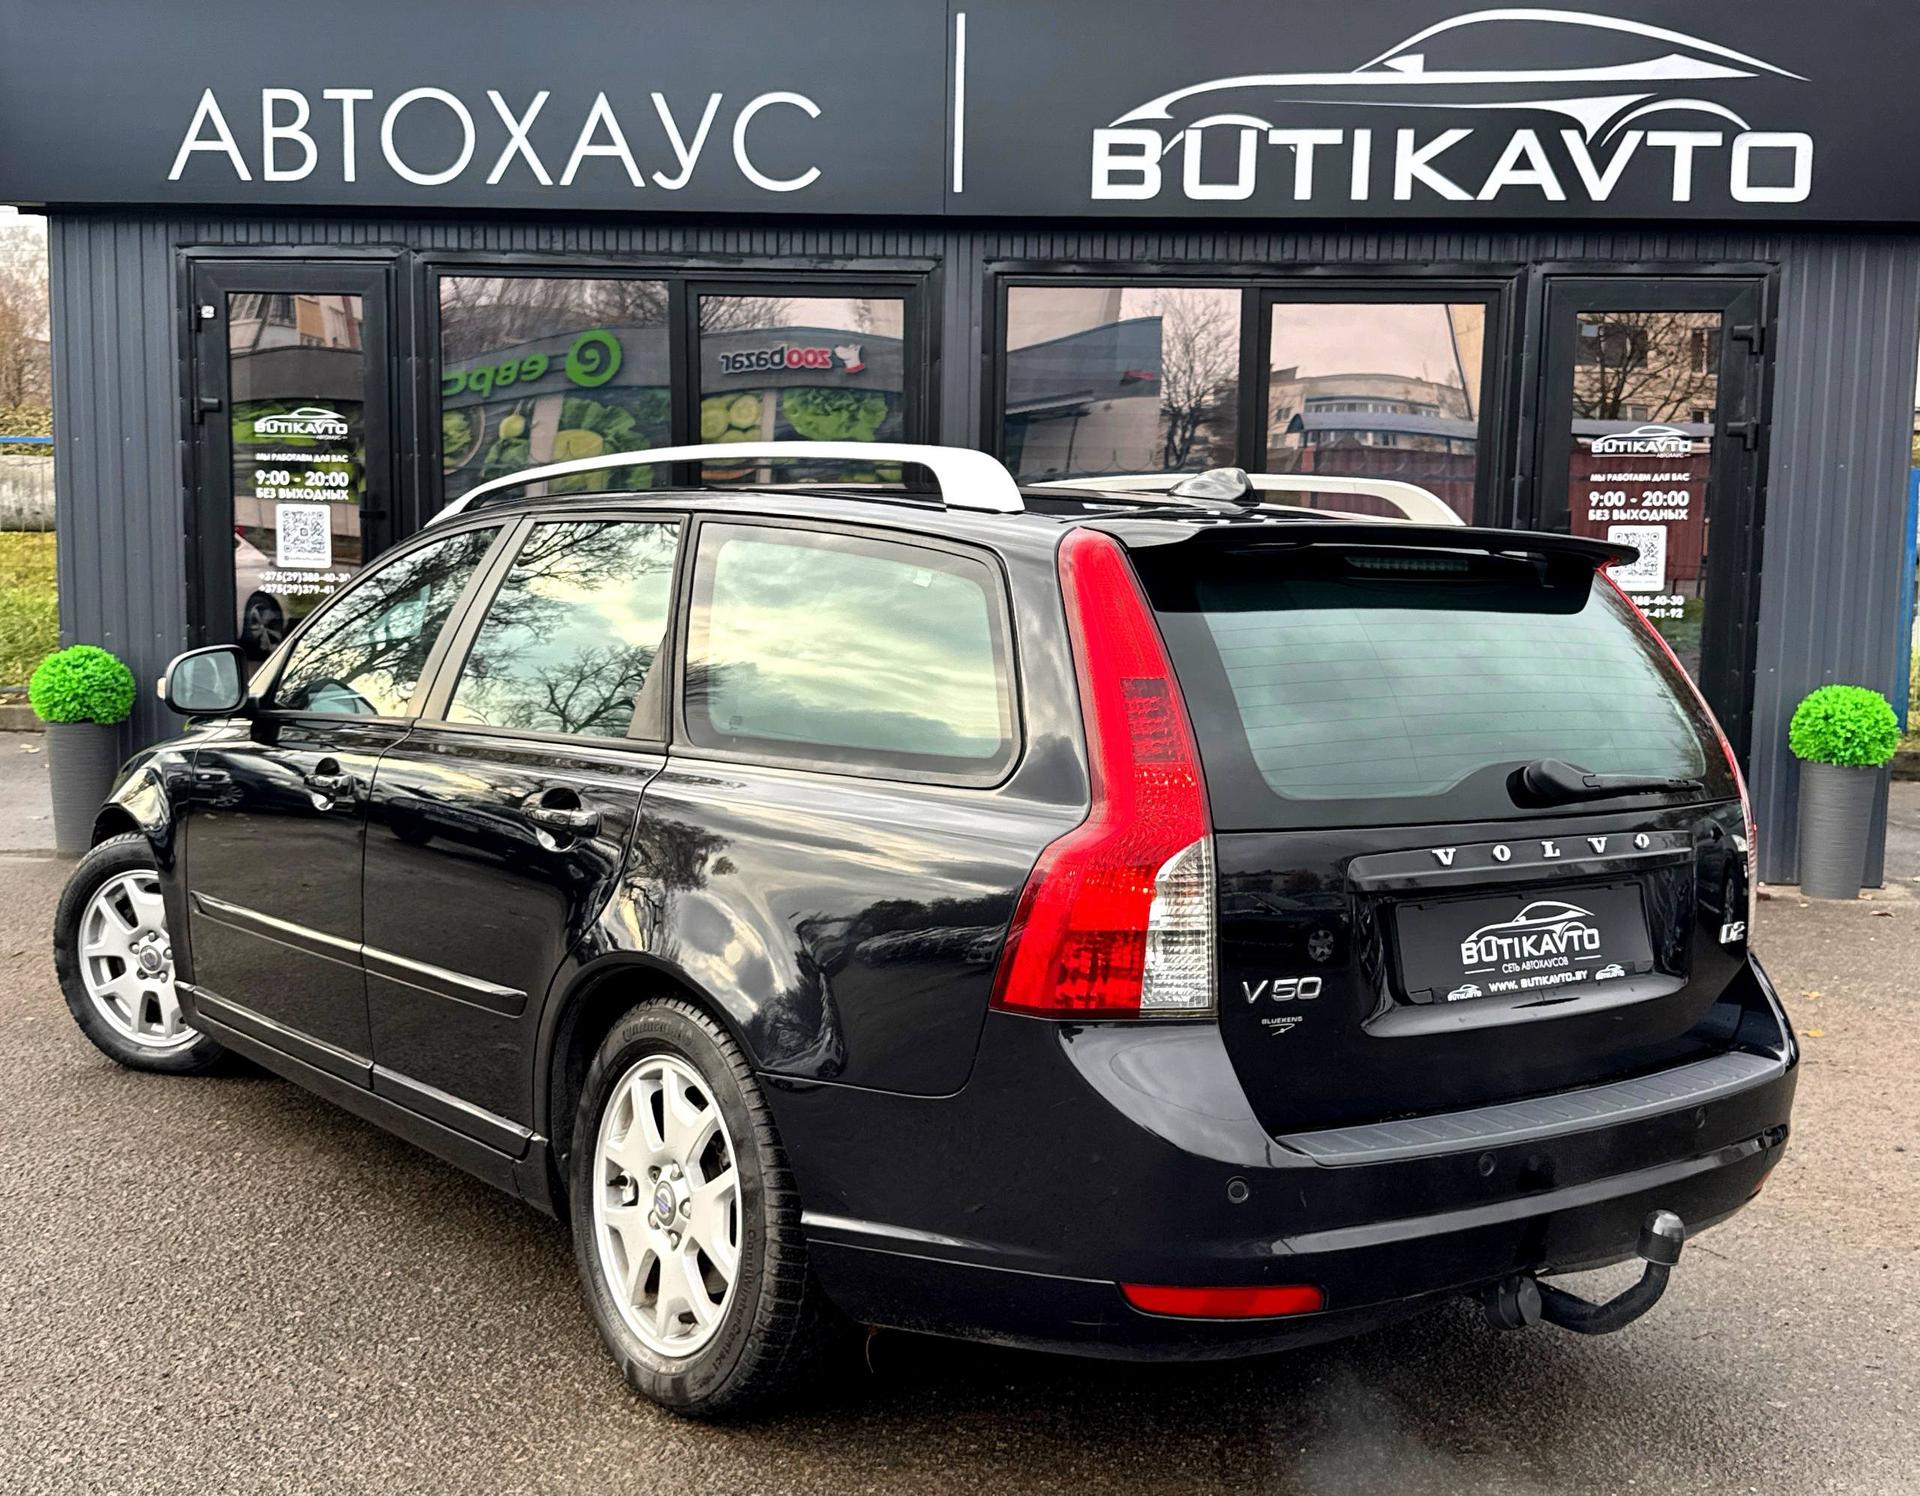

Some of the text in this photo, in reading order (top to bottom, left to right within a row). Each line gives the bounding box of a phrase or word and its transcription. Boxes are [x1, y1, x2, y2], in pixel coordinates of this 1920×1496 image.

[168, 88, 822, 191] АВТОХАУС
[1091, 113, 1814, 203] BUTIKAVTO
[254, 420, 348, 434] BUTIKAVTO
[1591, 440, 1692, 453] BUTIKAVTO
[255, 470, 290, 486] 9:00
[304, 471, 349, 487] 20:00
[1590, 473, 1690, 482] МЫ РАБОТАЕМ ДЛЯ ВАС
[255, 487, 349, 501] БЕЗ ВЫХОДНЫХ
[1589, 491, 1626, 507] 9:00
[1641, 490, 1690, 507] 20:00
[1588, 508, 1689, 521] БЕЗ ВЫХОДНЫХ
[1432, 833, 1650, 866] VOLVO
[1461, 928, 1600, 965] BUTIKAVTO
[1502, 956, 1569, 974] СЕТЬ АВТОХАУСОВ
[1489, 981, 1518, 993] WWW.
[1520, 970, 1588, 988] BUTIKAVTO.BY
[1243, 977, 1322, 1004] V50
